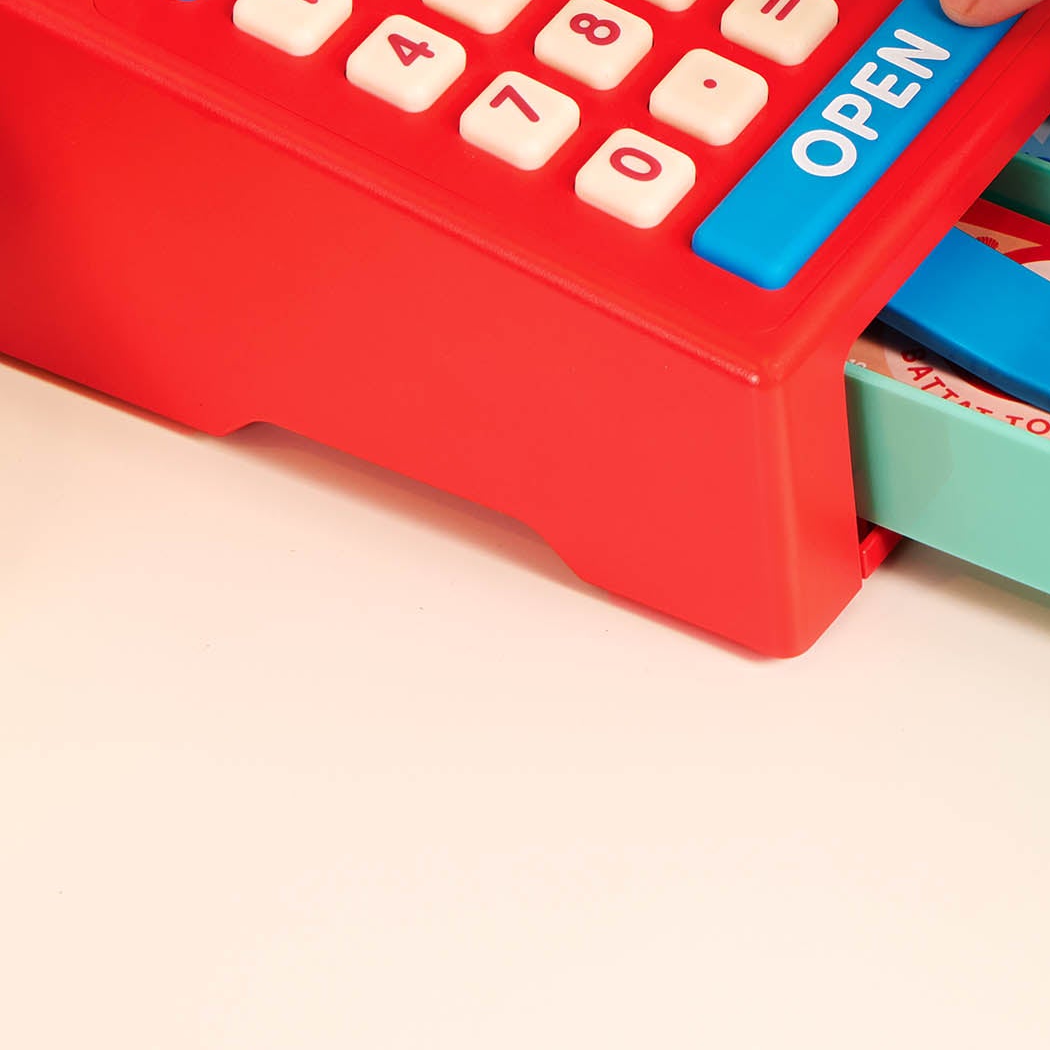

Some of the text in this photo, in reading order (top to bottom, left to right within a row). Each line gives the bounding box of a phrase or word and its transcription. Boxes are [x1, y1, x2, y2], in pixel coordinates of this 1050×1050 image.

[568, 12, 622, 47] 8
[387, 32, 436, 67] 4
[489, 84, 541, 123] 7
[791, 28, 951, 177] OPEN
[608, 146, 663, 182] 0
